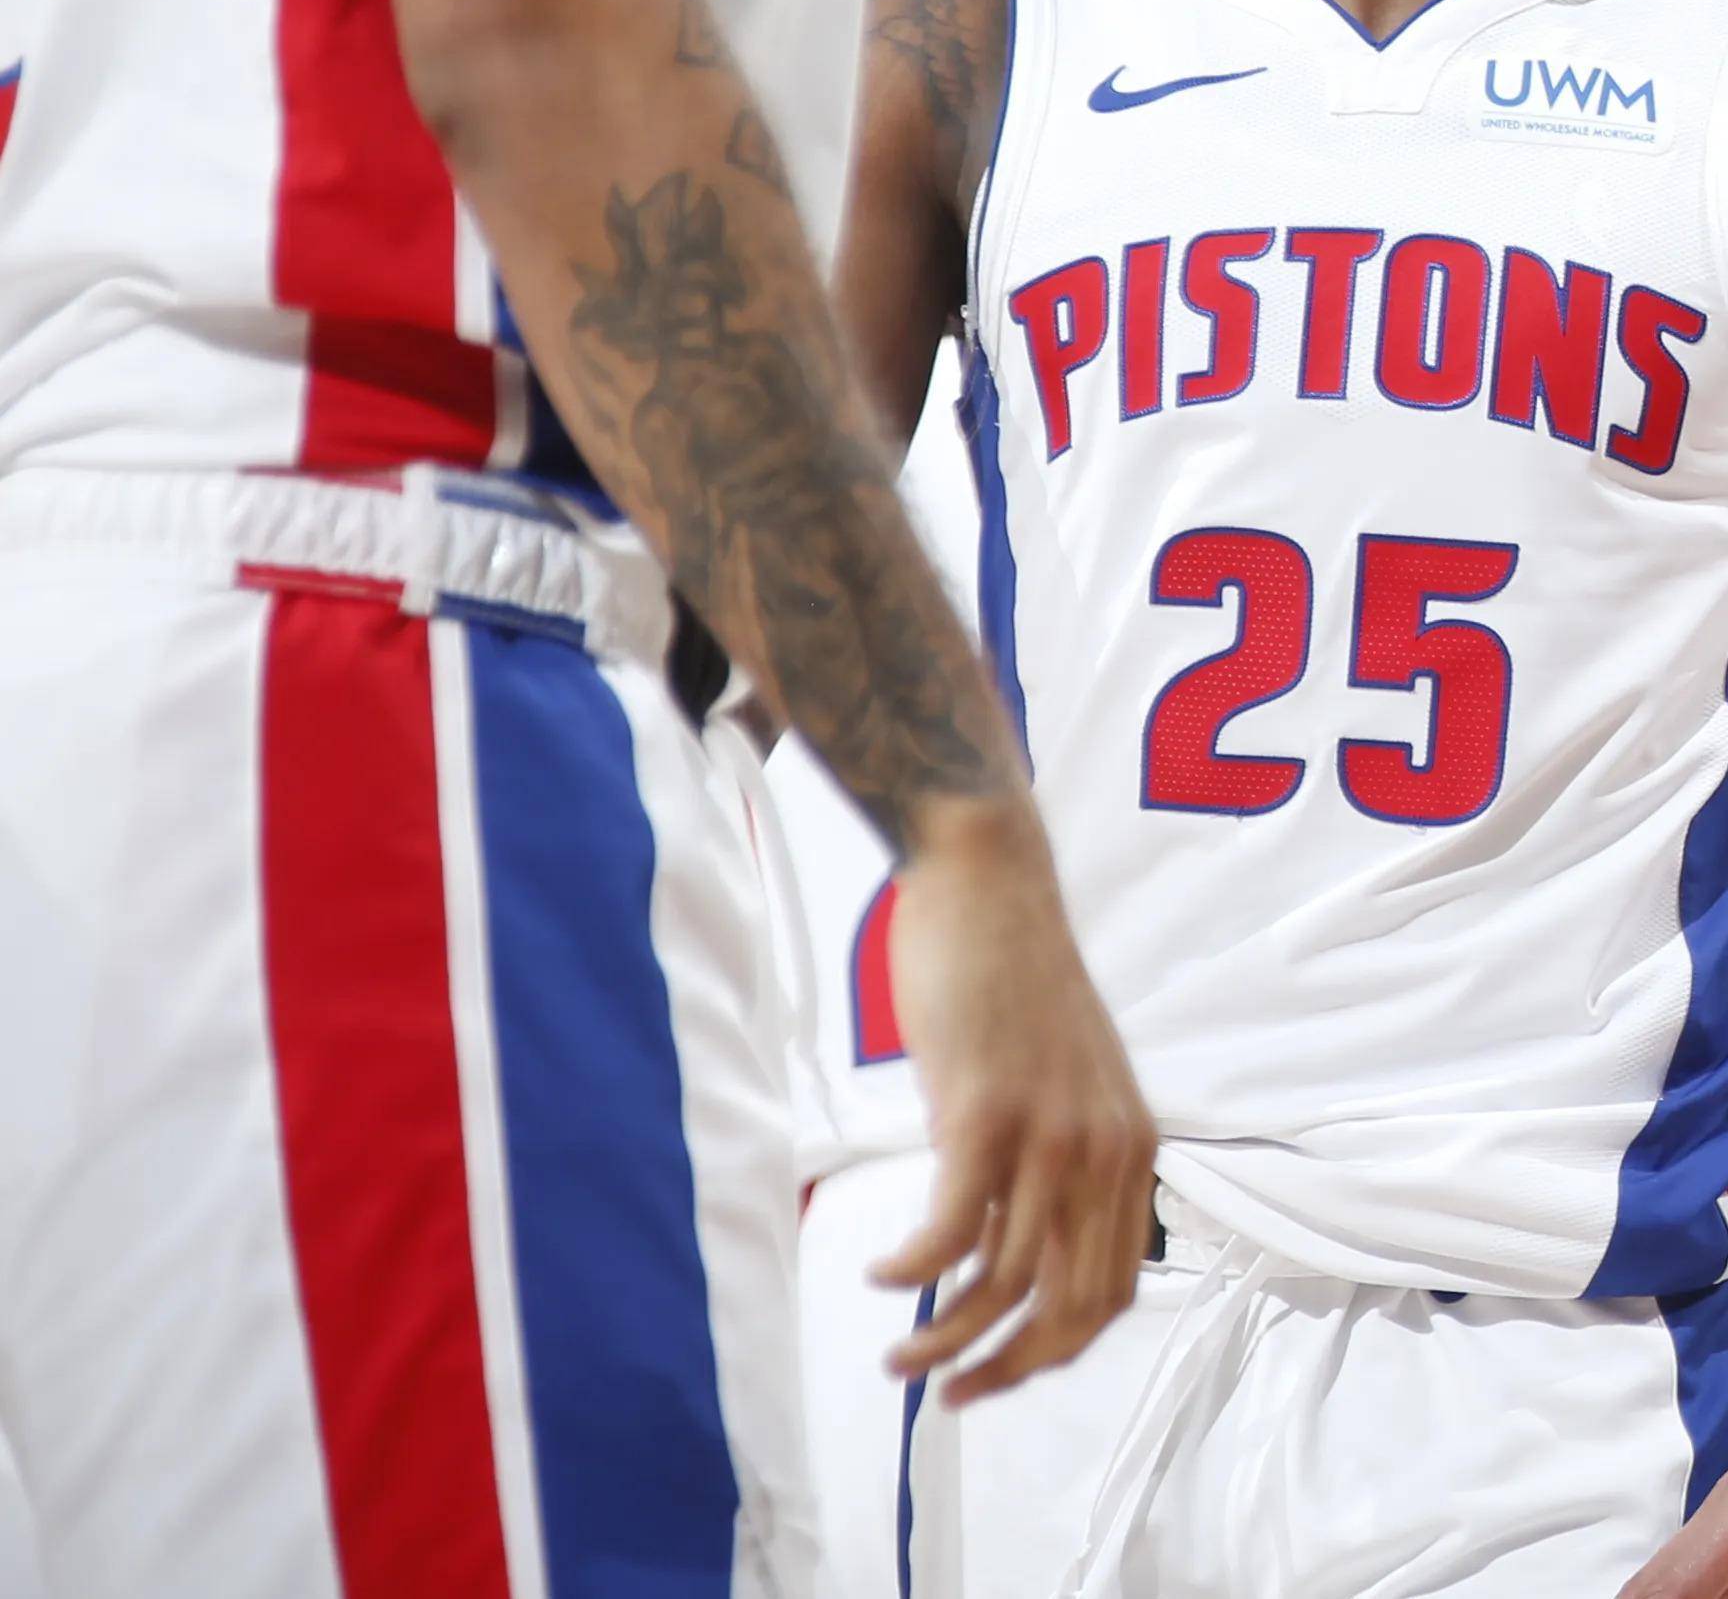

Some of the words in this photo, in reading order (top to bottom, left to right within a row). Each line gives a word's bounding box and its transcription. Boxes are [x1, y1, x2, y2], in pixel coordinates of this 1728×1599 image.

[1481, 119, 1520, 130] UNITED
[1525, 122, 1589, 136] WHOLESALE
[1593, 129, 1655, 143] MORTGAGE
[1485, 60, 1656, 122] UWM
[1010, 227, 1706, 476] PISTONS
[1141, 527, 1519, 827] 25
